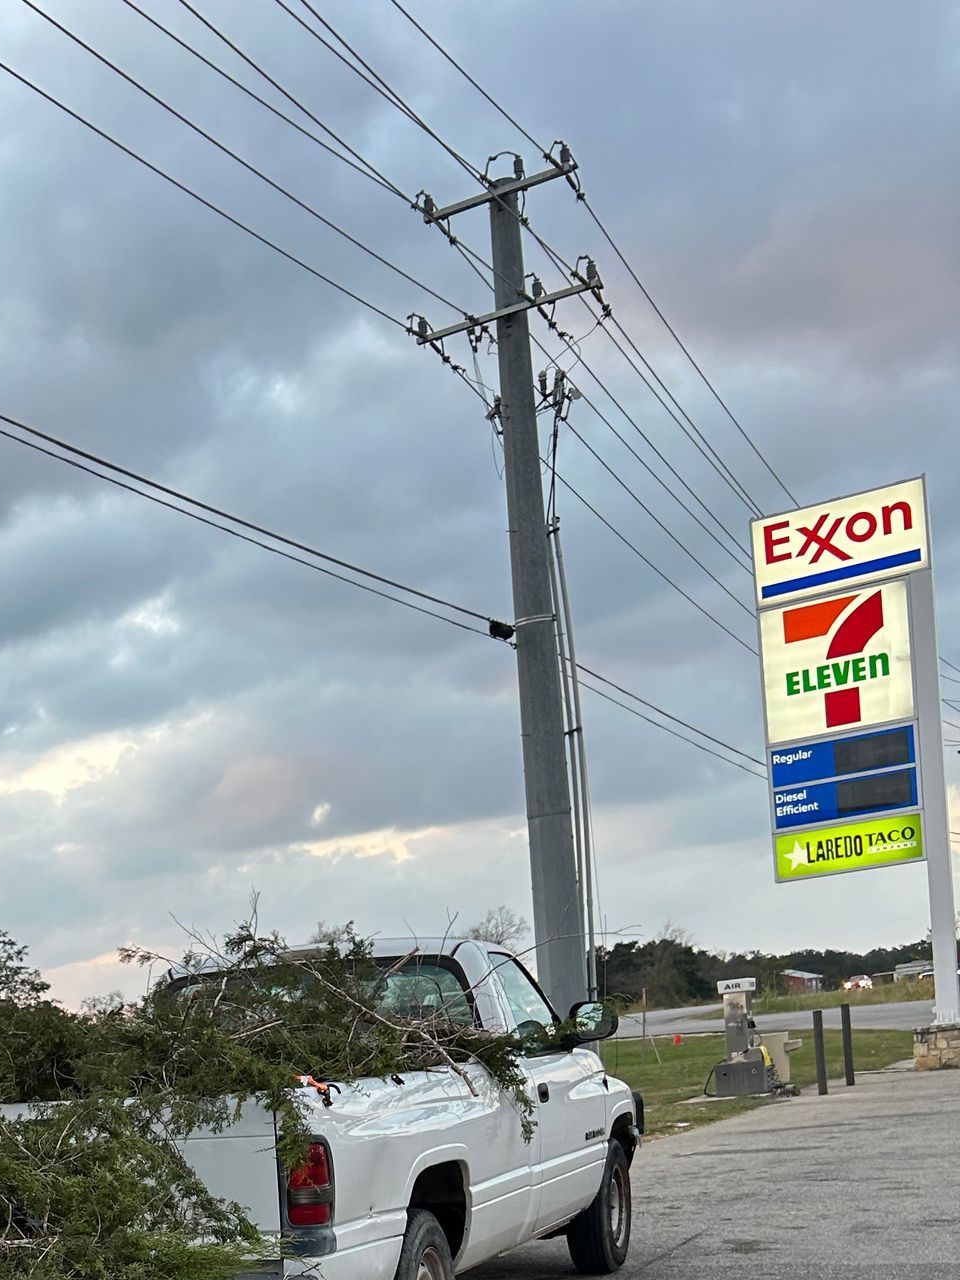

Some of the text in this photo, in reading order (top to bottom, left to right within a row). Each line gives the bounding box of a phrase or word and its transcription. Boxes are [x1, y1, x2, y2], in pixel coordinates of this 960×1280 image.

[763, 501, 913, 565] Exxon
[772, 749, 813, 765] Regular
[775, 789, 807, 804] Diesel
[776, 801, 819, 817] Efficient
[806, 826, 916, 864] LAREDO TACO
